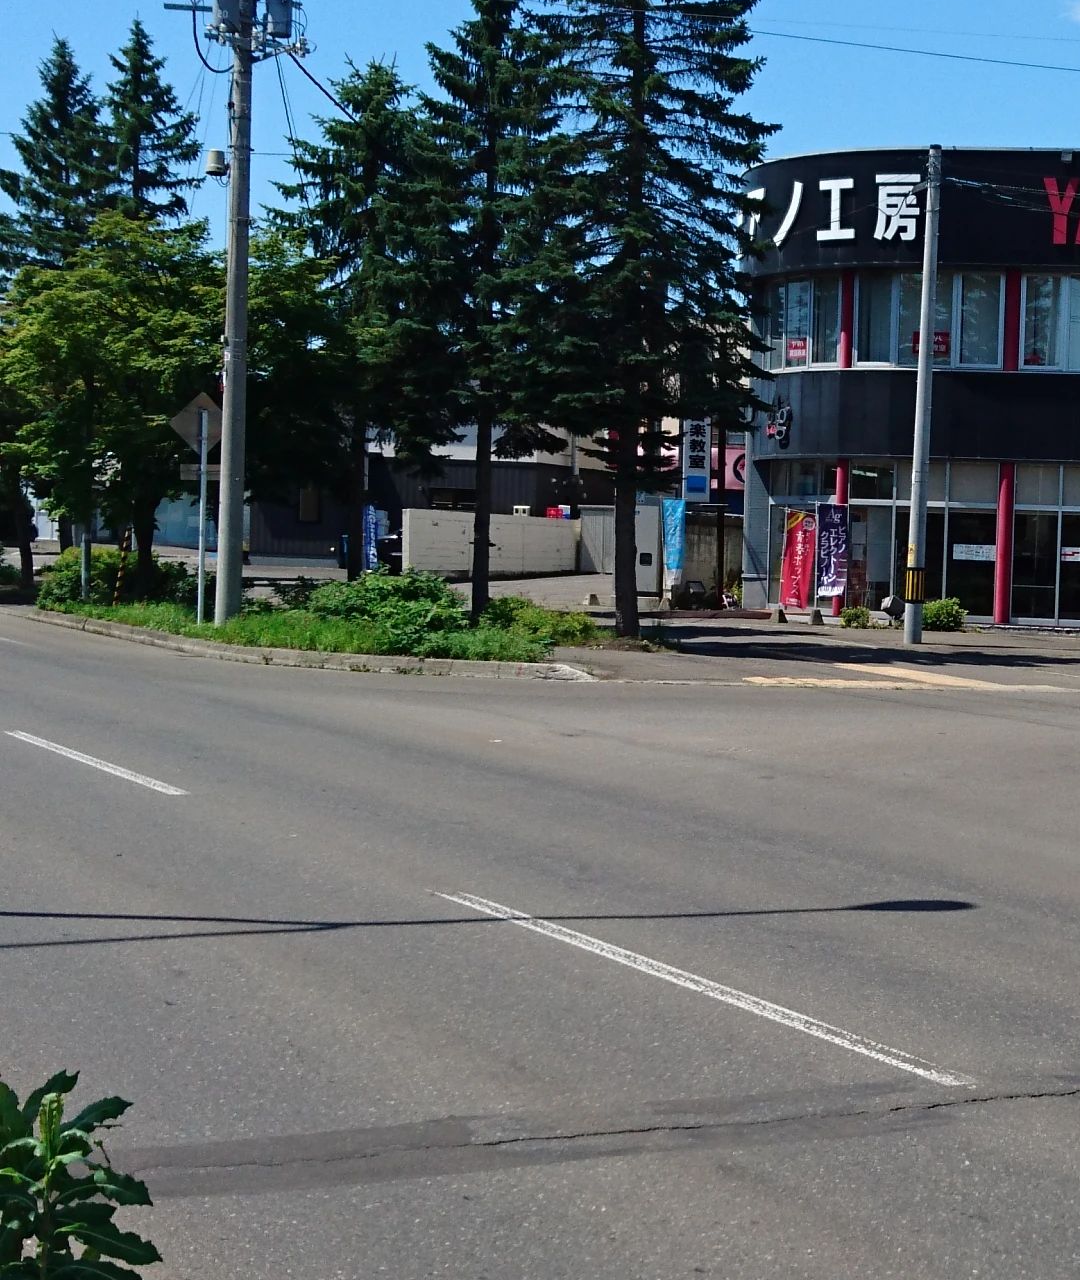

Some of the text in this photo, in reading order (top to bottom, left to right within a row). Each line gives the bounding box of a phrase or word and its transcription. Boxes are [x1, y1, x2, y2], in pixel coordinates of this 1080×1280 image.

[688, 418, 706, 469] 楽教室
[790, 531, 804, 595] 青春ポップス
[820, 531, 829, 585] クラビノーバ
[828, 528, 838, 583] エレクトーン
[838, 526, 846, 553] ピアノ
